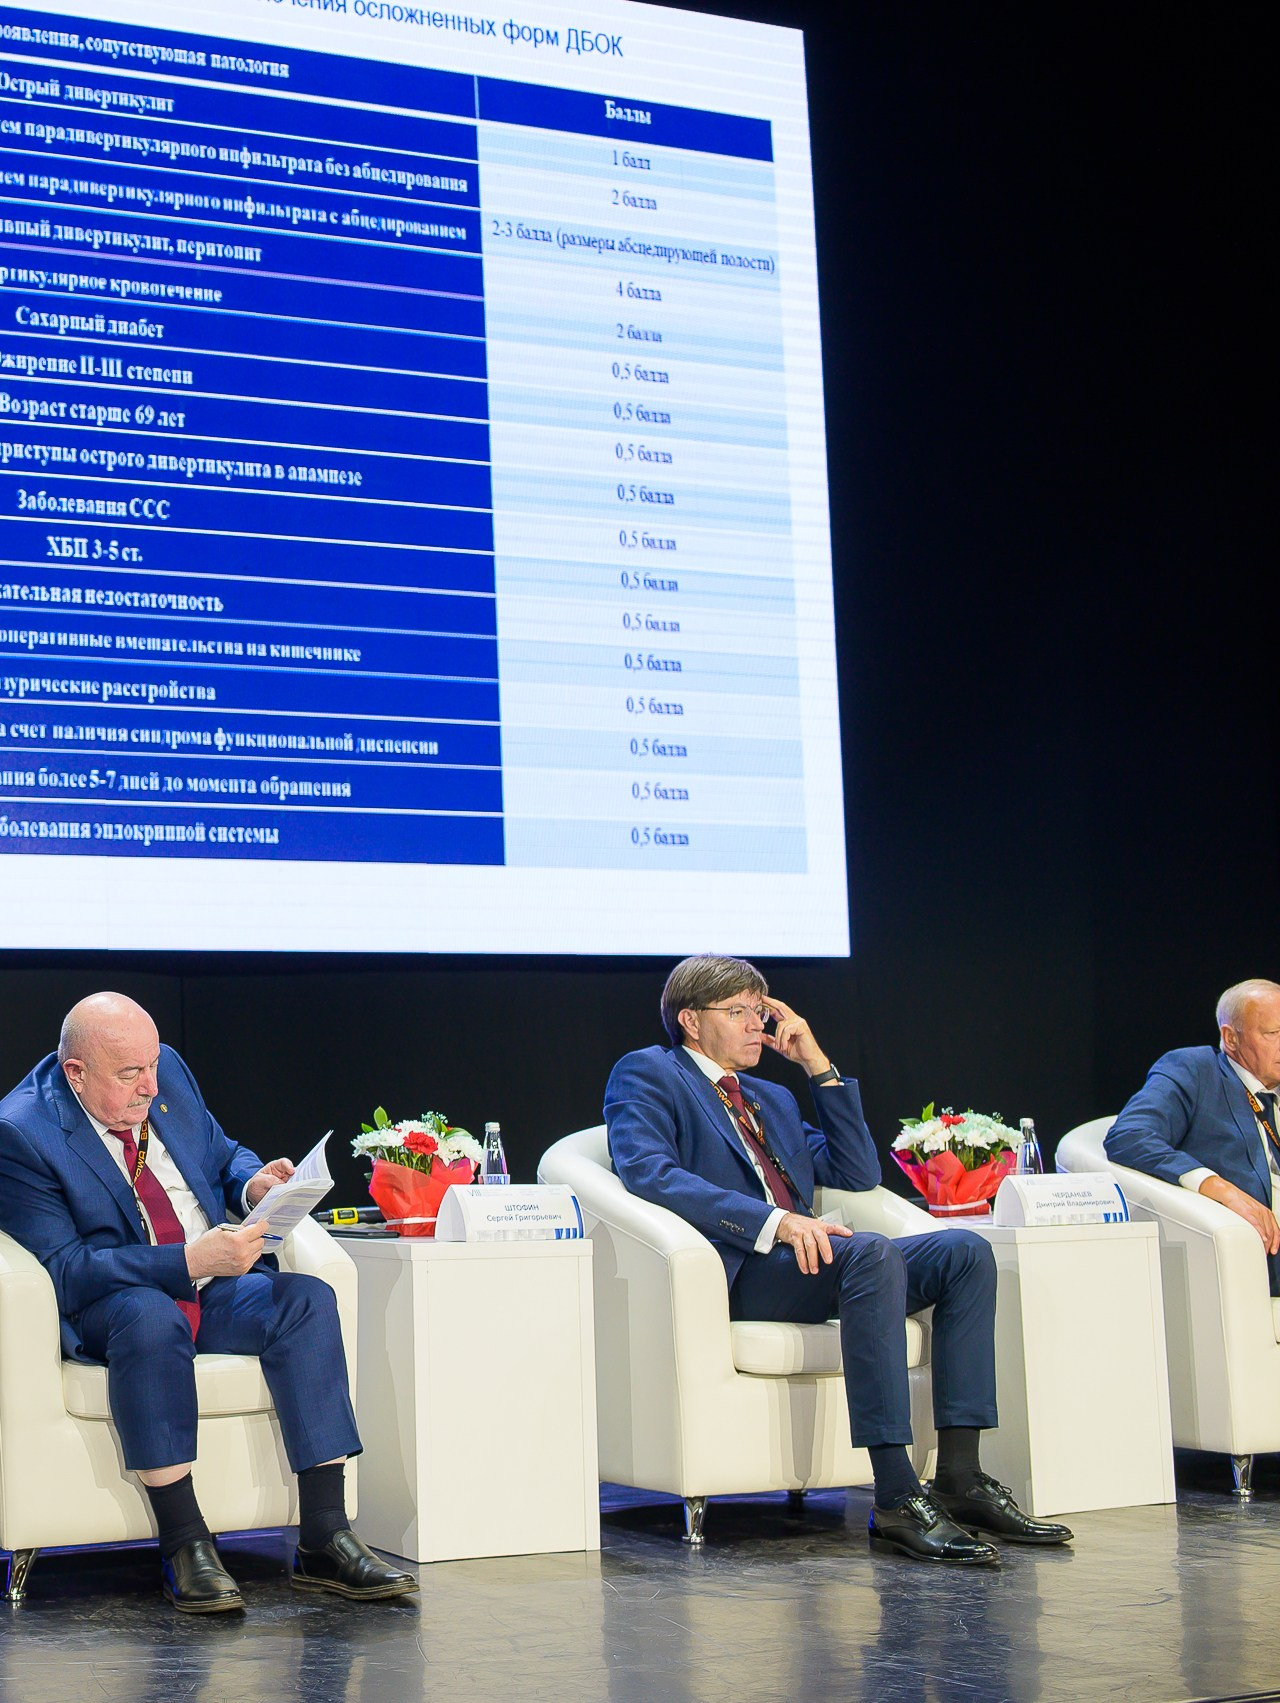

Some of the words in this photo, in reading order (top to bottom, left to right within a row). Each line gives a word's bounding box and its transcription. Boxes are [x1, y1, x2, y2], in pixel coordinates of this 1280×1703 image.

[354, 0, 496, 37] осложненных
[503, 19, 559, 48] форм
[566, 28, 624, 57] ДБОК
[86, 37, 206, 65] сопутствующая
[211, 54, 289, 77] патология
[65, 85, 173, 113] дивертикулит
[604, 99, 652, 125] Баллы
[220, 147, 322, 174] инфильтрата
[326, 158, 349, 176] без
[613, 149, 618, 166] 1
[623, 149, 651, 170] балл
[224, 196, 326, 224] инфильтрата
[330, 213, 337, 223] с
[612, 189, 619, 205] 2
[623, 189, 658, 210] балла
[492, 220, 513, 236] 2-3
[516, 221, 553, 243] балла
[54, 225, 173, 253] дивертикулит,
[177, 240, 261, 261] перитонит
[110, 279, 221, 301] кровотечение
[617, 281, 623, 297] 4
[627, 283, 662, 301] балла
[16, 307, 105, 334] Сахарный
[108, 320, 163, 337] диабет
[617, 324, 623, 339] 2
[627, 325, 663, 343] балла
[81, 357, 122, 377] II-III
[127, 366, 192, 384] степени
[612, 362, 631, 380] 0,5
[634, 364, 669, 383] балла
[0, 393, 66, 420] Возраст
[70, 404, 130, 425] старше
[136, 406, 154, 424] 69
[158, 412, 185, 427] лет
[613, 402, 632, 421] 0,5
[636, 404, 671, 424] балла
[615, 443, 634, 461] 0,5
[638, 445, 673, 464] балла
[80, 449, 144, 471] острого
[148, 455, 271, 480] дивертикулита
[275, 465, 284, 478] в
[289, 466, 362, 485] анамнезе
[19, 489, 126, 515] Заболевания
[130, 498, 169, 518] ССС
[617, 484, 636, 502] 0,5
[639, 486, 675, 505] балла
[47, 536, 88, 558] ХБП
[93, 540, 118, 560] 3-5
[122, 548, 142, 561] ст.
[619, 530, 638, 549] 0,5
[642, 532, 677, 551] балла
[621, 571, 640, 589] 0,5
[644, 573, 678, 592] балла
[86, 590, 223, 611] недостаточность
[623, 613, 642, 631] 0,5
[645, 614, 680, 632] балла
[116, 636, 243, 655] вмешательства
[247, 643, 266, 656] на
[271, 645, 360, 661] кишечнике
[624, 654, 643, 672] 0,5
[647, 655, 682, 672] балла
[103, 680, 215, 703] расстройства
[626, 697, 645, 714] 0,5
[649, 698, 684, 715] балла
[11, 725, 45, 738] счет
[53, 726, 128, 741] наличия
[131, 730, 211, 749] синдрома
[214, 728, 353, 751] функциональной
[357, 739, 438, 754] диспепсии
[630, 738, 649, 757] 0,5
[652, 739, 687, 757] балла
[39, 768, 87, 787] более
[90, 770, 115, 787] 5-7
[119, 772, 159, 790] дней
[162, 777, 182, 791] до
[188, 778, 257, 793] момента
[261, 776, 351, 800] обращения
[632, 782, 651, 800] 0,5
[654, 783, 689, 801] балла
[95, 823, 205, 846] эндокринной
[209, 827, 278, 843] системы
[631, 827, 650, 846] 0,5
[654, 828, 689, 846] балла
[1036, 1201, 1066, 1209] Дмитрий
[1067, 1200, 1115, 1208] Владимирович
[1052, 1191, 1093, 1199] ЧЕРДАНЦЕВ
[487, 1213, 514, 1223] Сергей
[515, 1213, 562, 1222] Григорьевич
[505, 1204, 540, 1212] ШТОФИН
